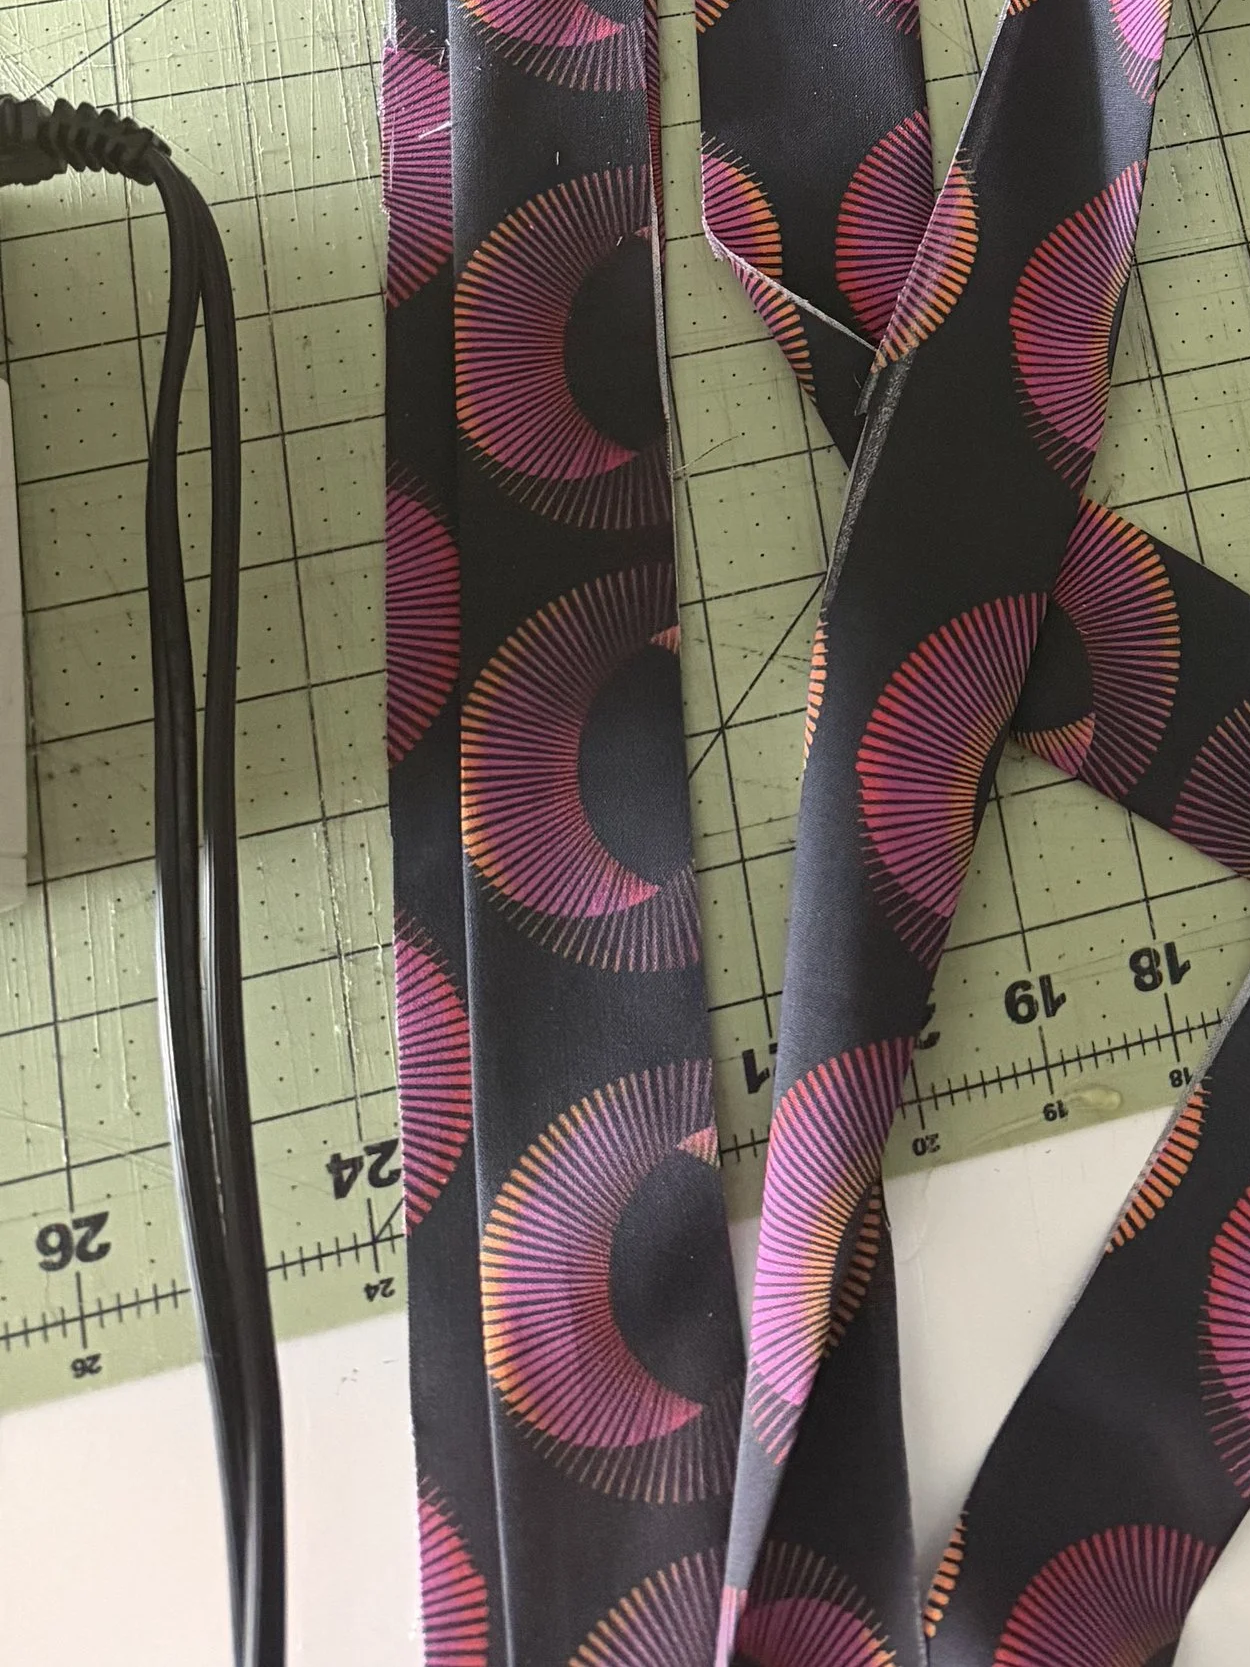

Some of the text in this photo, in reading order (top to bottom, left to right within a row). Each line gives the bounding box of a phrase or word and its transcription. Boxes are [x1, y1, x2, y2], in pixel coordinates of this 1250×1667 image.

[1128, 941, 1192, 993] 18
[1004, 974, 1067, 1026] 19
[1169, 1066, 1193, 1089] 18
[1043, 1100, 1069, 1123] 19
[912, 1133, 941, 1157] 20
[326, 1138, 402, 1200] 24
[35, 1211, 112, 1272] 26
[364, 1277, 396, 1302] 24
[72, 1353, 103, 1379] 26
